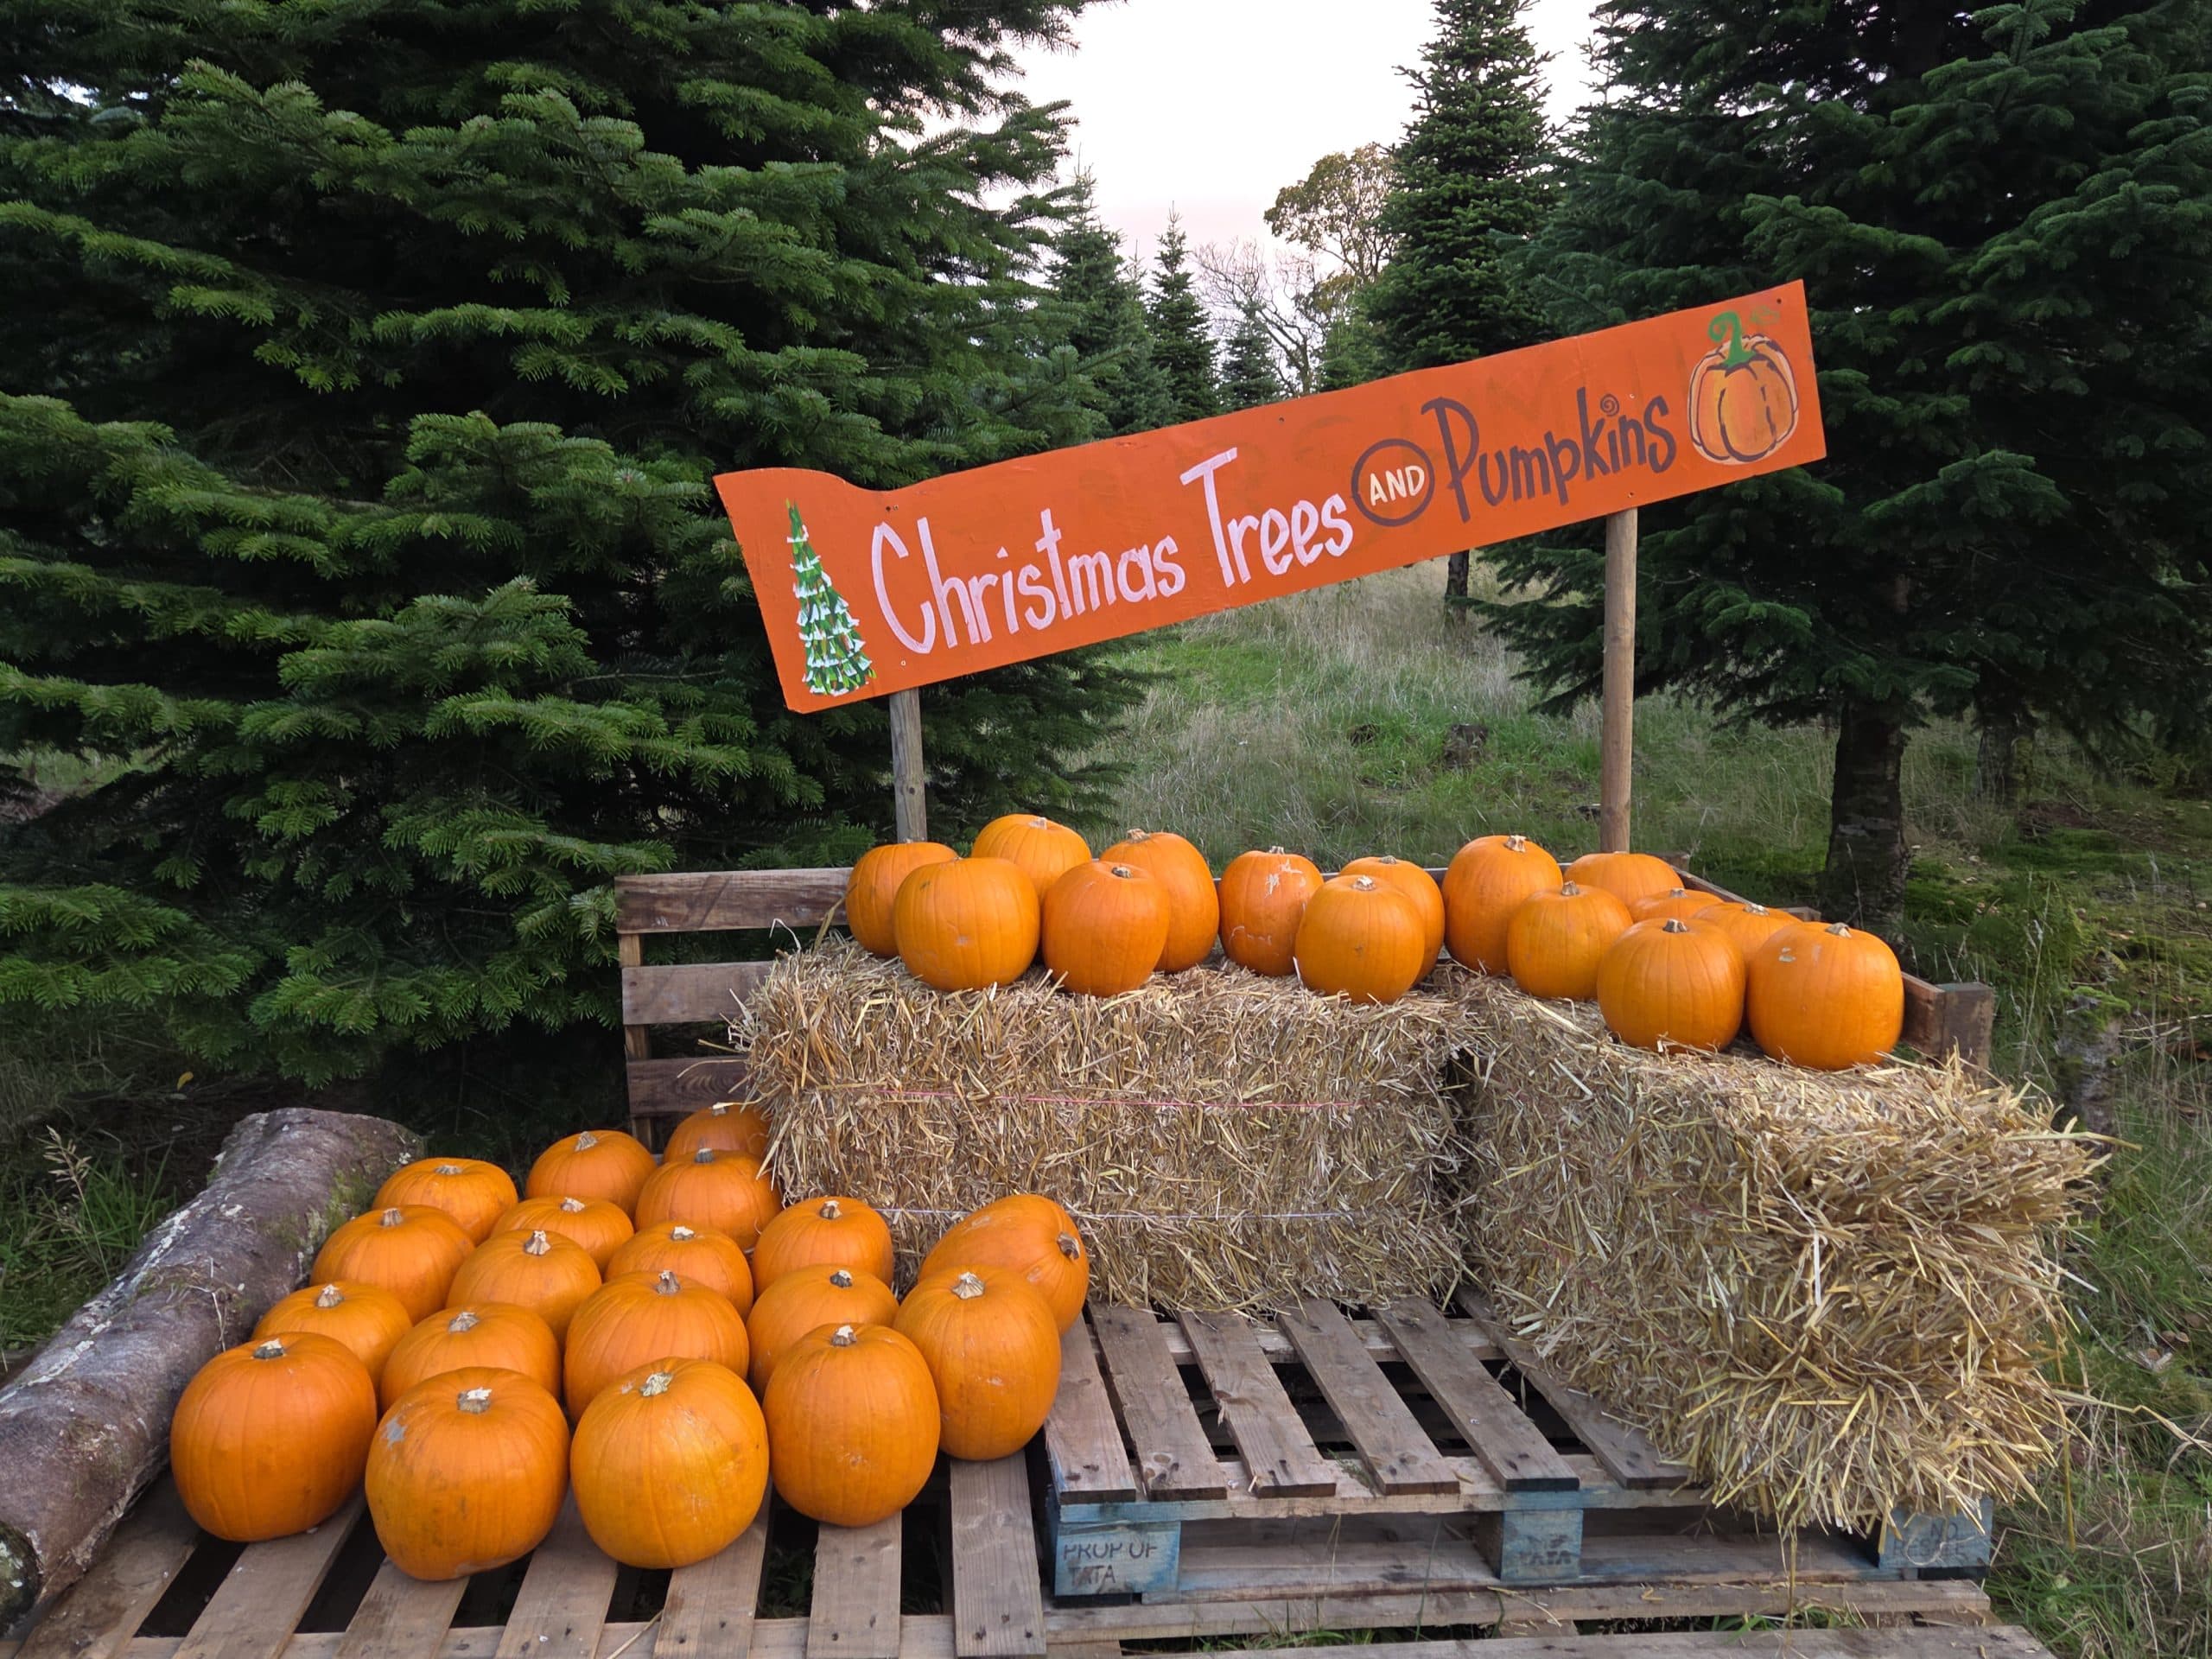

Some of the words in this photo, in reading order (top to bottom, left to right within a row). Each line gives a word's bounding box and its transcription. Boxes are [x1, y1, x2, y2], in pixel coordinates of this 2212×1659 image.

[872, 508, 1186, 655] Christmas
[1179, 447, 1354, 588] Trees
[1368, 464, 1426, 507] AND
[1421, 386, 1676, 524] Pumpkins
